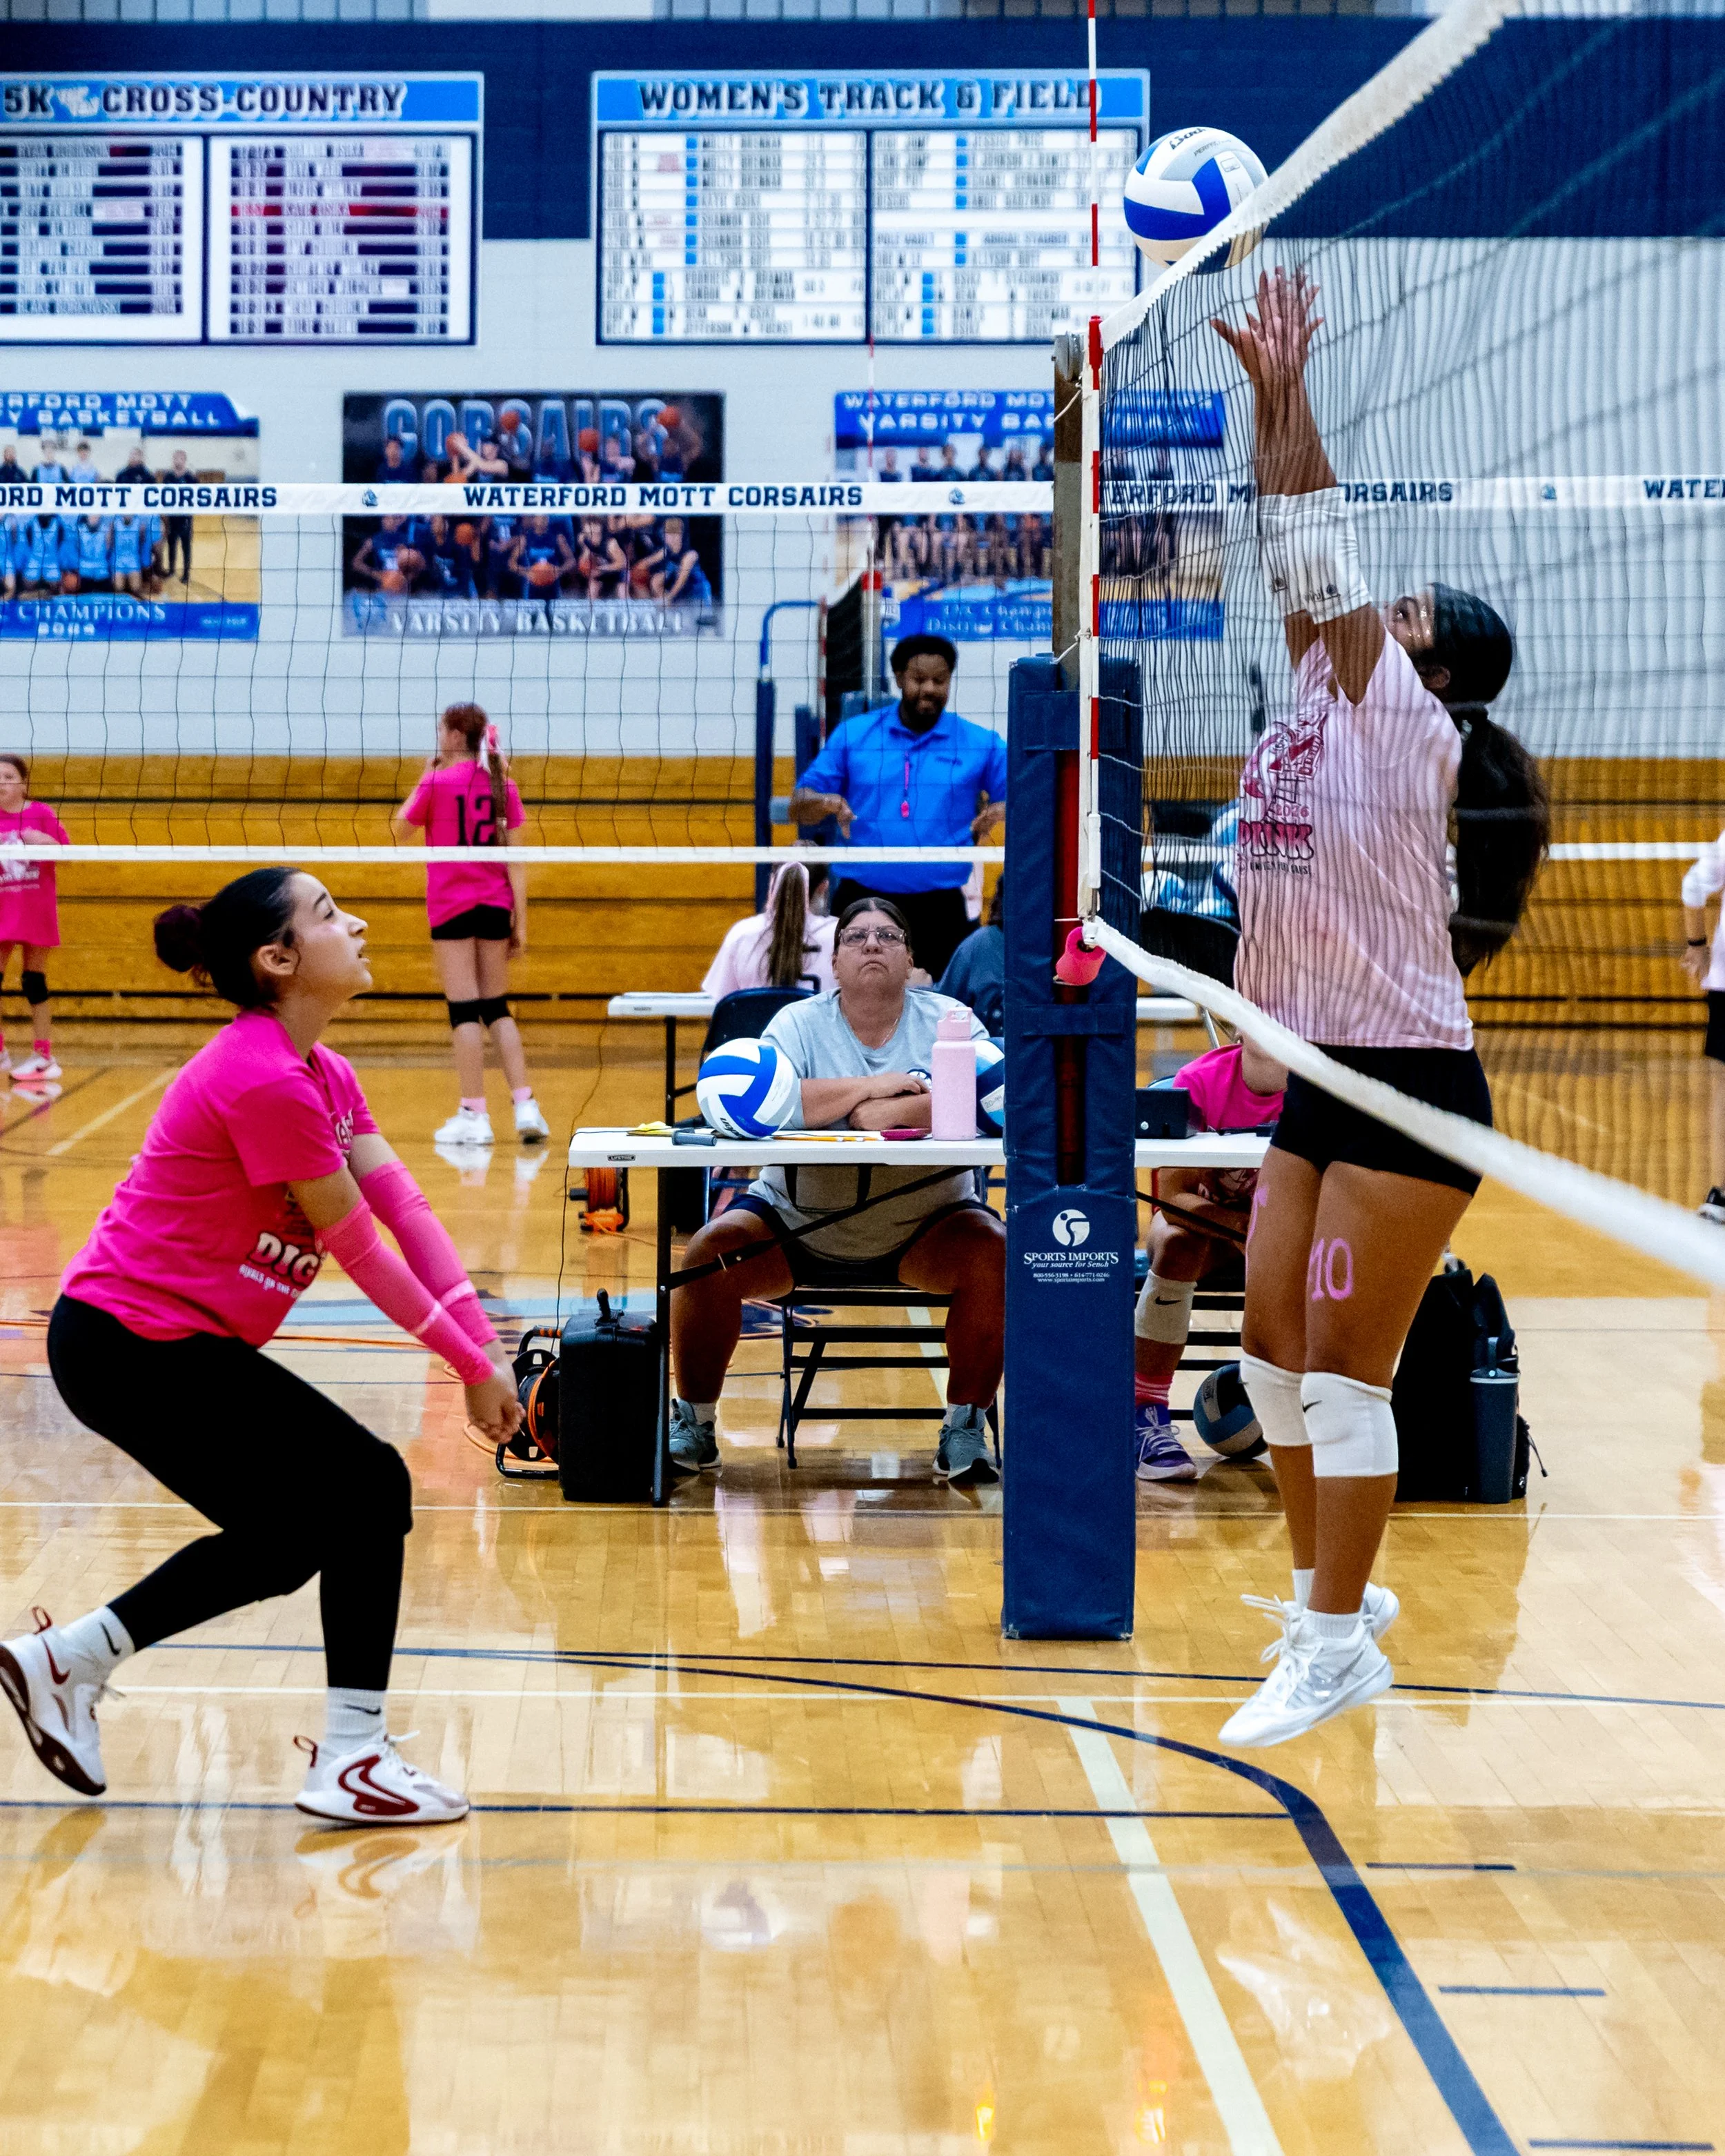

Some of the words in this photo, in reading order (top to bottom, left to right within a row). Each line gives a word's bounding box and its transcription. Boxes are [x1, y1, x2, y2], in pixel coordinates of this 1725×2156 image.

[5, 83, 52, 113] 5K
[103, 84, 404, 113] CROSS-COUNTRY
[640, 81, 804, 110] WOMEN'S
[820, 81, 944, 110] TRACK
[993, 81, 1095, 109] FIELD
[116, 393, 191, 409] MOTT
[843, 393, 996, 409] WATERFORD
[37, 411, 221, 426] BASKETBALL
[859, 413, 986, 431] VARSITY
[384, 398, 671, 461] CORSAIRS
[55, 487, 131, 507] MOTT
[144, 487, 277, 507] CORSAIRS
[463, 486, 626, 506] WATERFORD
[638, 486, 716, 506] MOTT
[728, 486, 863, 506] CORSAIRS
[1644, 479, 1725, 498] WATE
[19, 605, 166, 619] CHAMPIONS
[391, 611, 501, 633] VARSITY
[515, 611, 683, 633] BASKETBALL
[456, 795, 496, 847] 12
[1239, 820, 1314, 860] PINK
[1024, 1252, 1066, 1265] SPORTS
[1069, 1252, 1118, 1265] IMPORTS
[1310, 1238, 1354, 1300] 10
